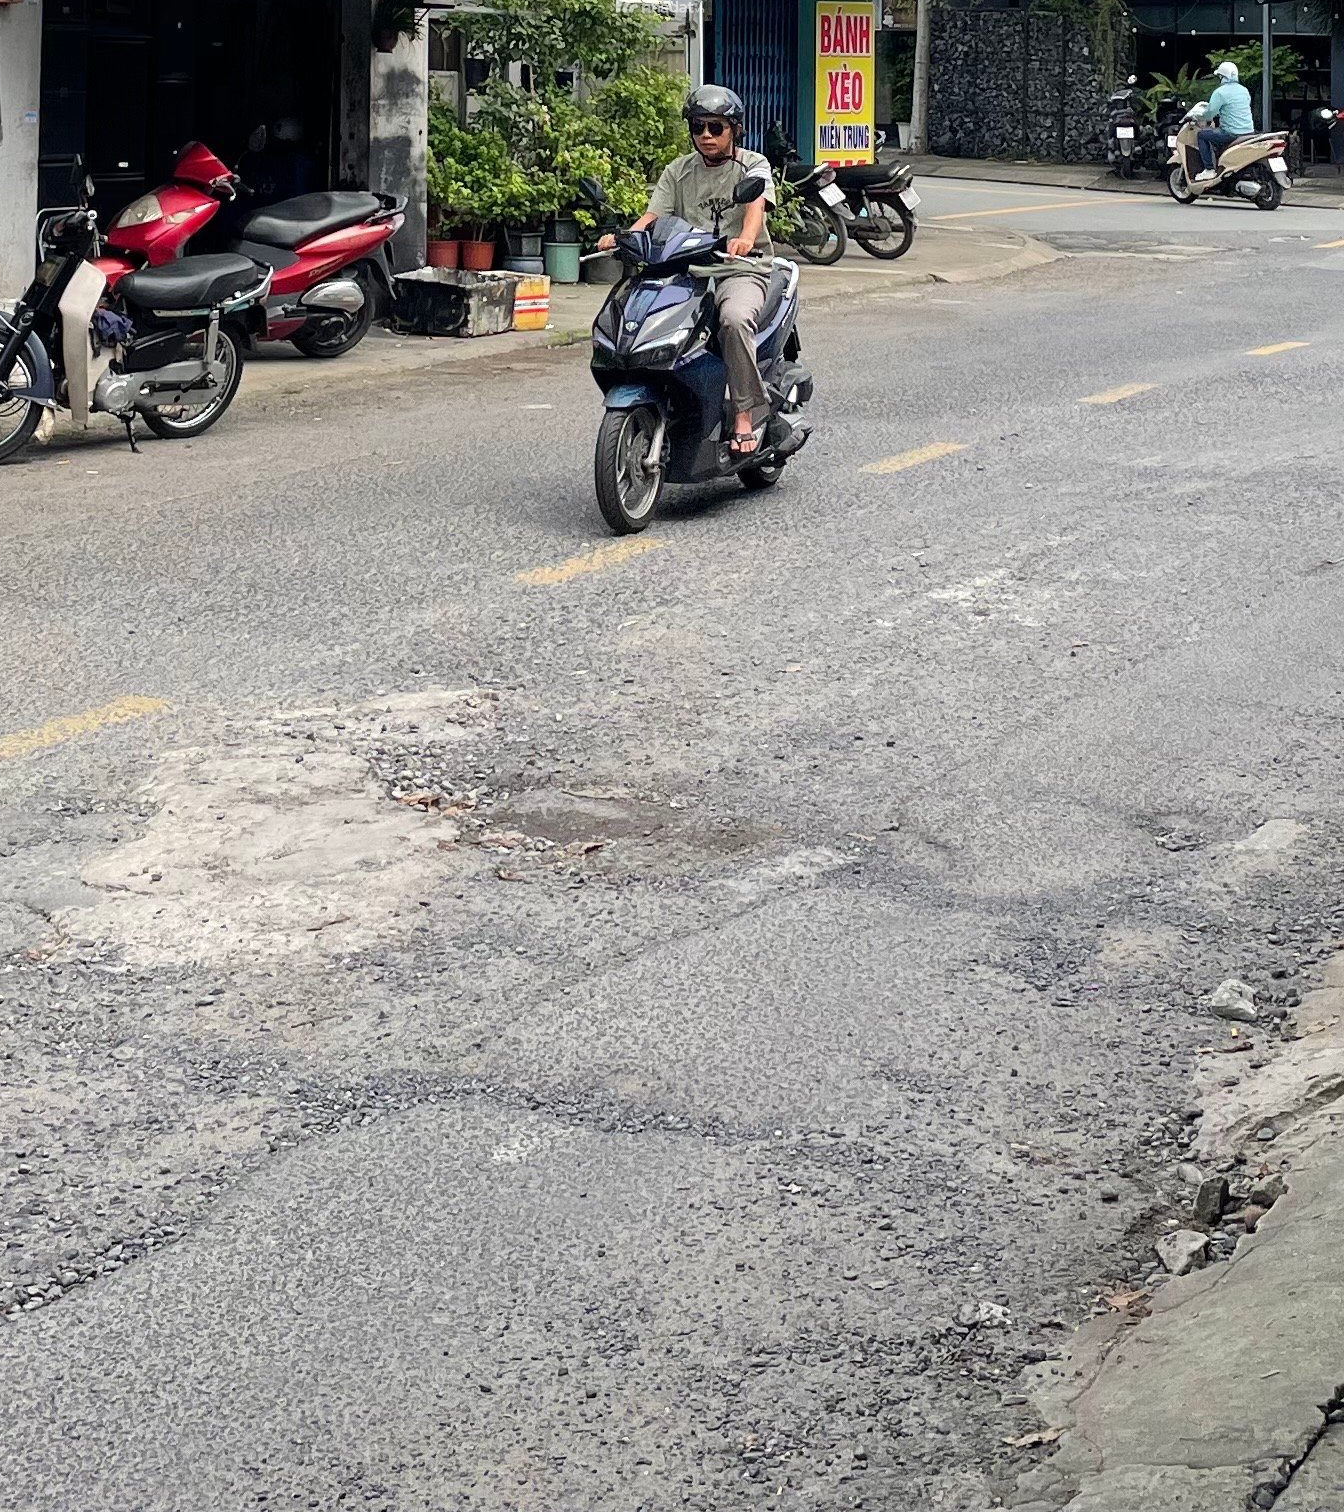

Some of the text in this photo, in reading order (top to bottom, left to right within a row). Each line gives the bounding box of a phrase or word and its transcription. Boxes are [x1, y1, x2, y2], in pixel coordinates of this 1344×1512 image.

[820, 7, 870, 54] BÁNH
[827, 63, 864, 110] XÈO
[843, 125, 870, 149] TRUNG
